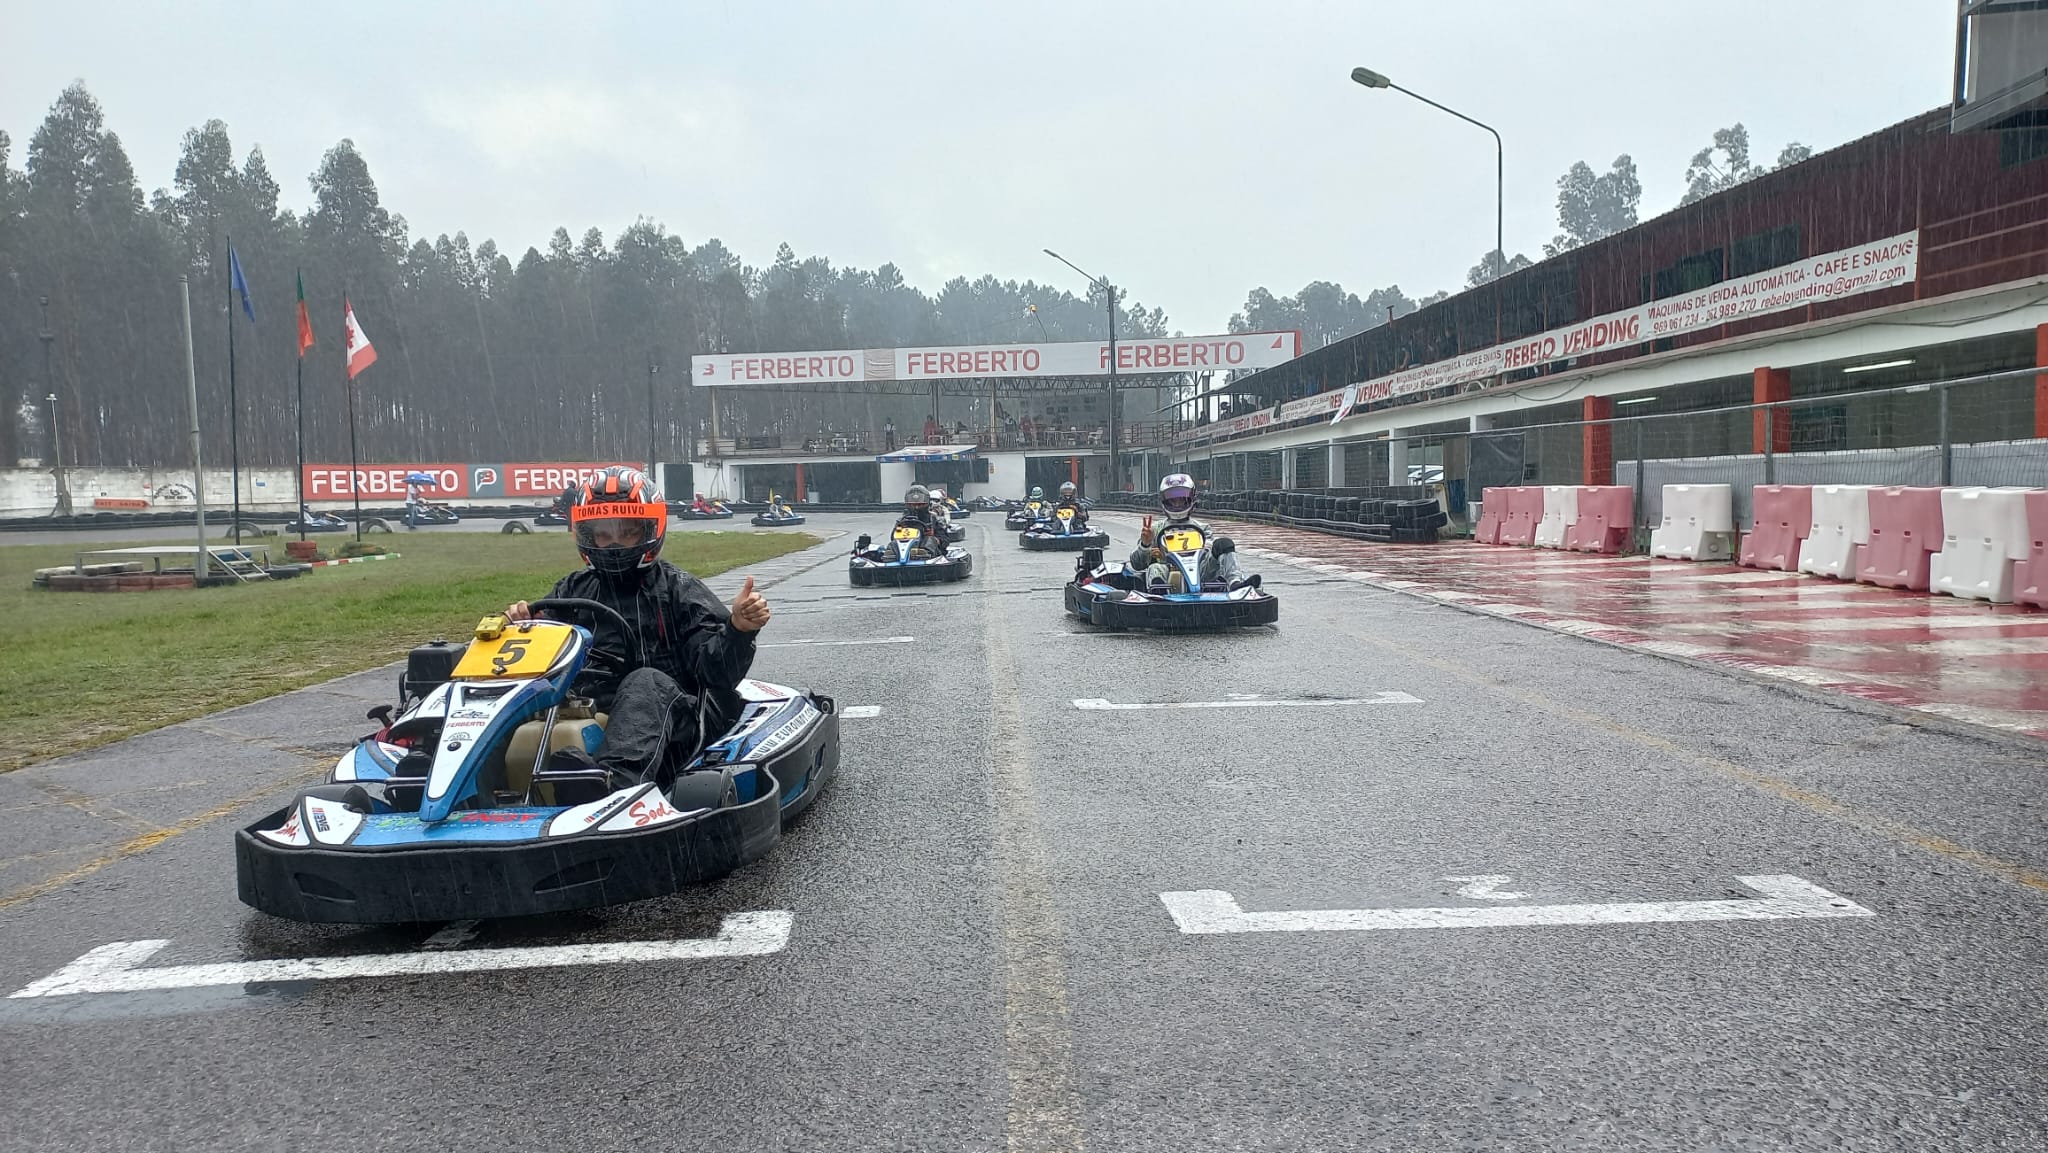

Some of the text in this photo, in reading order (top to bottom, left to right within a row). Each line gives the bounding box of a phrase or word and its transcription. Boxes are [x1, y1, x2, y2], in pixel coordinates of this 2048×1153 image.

[1695, 295, 1706, 308] DE
[1709, 286, 1738, 305] VENDA
[1814, 254, 1849, 278] CAFÉ
[1852, 254, 1860, 269] E
[1863, 239, 1914, 267] SNACKS
[1719, 302, 1737, 319] 989
[1562, 314, 1640, 356] VENDING
[731, 355, 854, 381] FERBERTO
[907, 348, 1040, 376] FERBERTO
[1100, 341, 1245, 369] FERBERTO
[612, 505, 645, 516] RUIVO
[1178, 537, 1190, 551] 7
[492, 638, 532, 667] 5
[629, 800, 674, 826] Sodi
